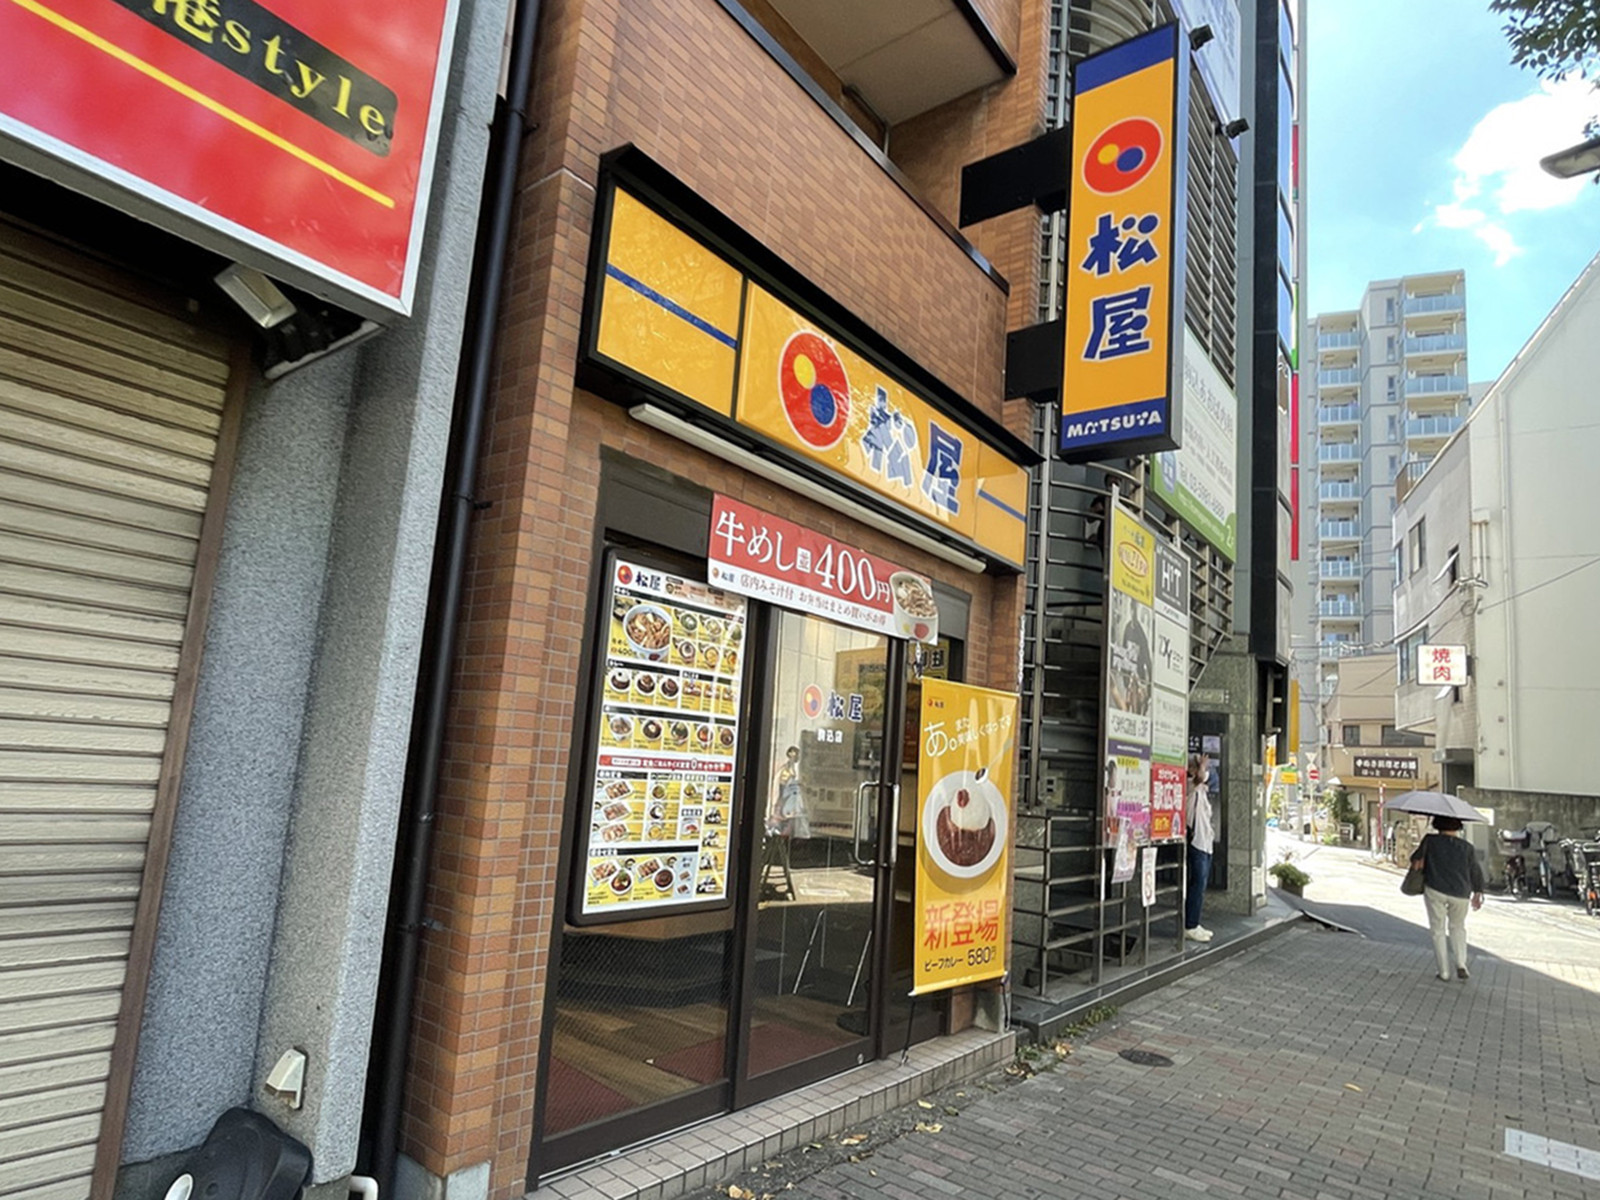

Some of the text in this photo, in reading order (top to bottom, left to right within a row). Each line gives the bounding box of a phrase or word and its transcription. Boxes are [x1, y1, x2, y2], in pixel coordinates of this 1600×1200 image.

[1080, 212, 1159, 361] 松屋
[1066, 410, 1162, 439] MATSUYA
[860, 383, 964, 517] 松屋
[635, 571, 662, 591] 松屋
[740, 573, 794, 601] 店内みそ汁付
[1432, 648, 1451, 681] 焼肉
[827, 691, 863, 723] 松屋
[924, 901, 999, 950] 新登場
[924, 957, 964, 973] ビーフカレー
